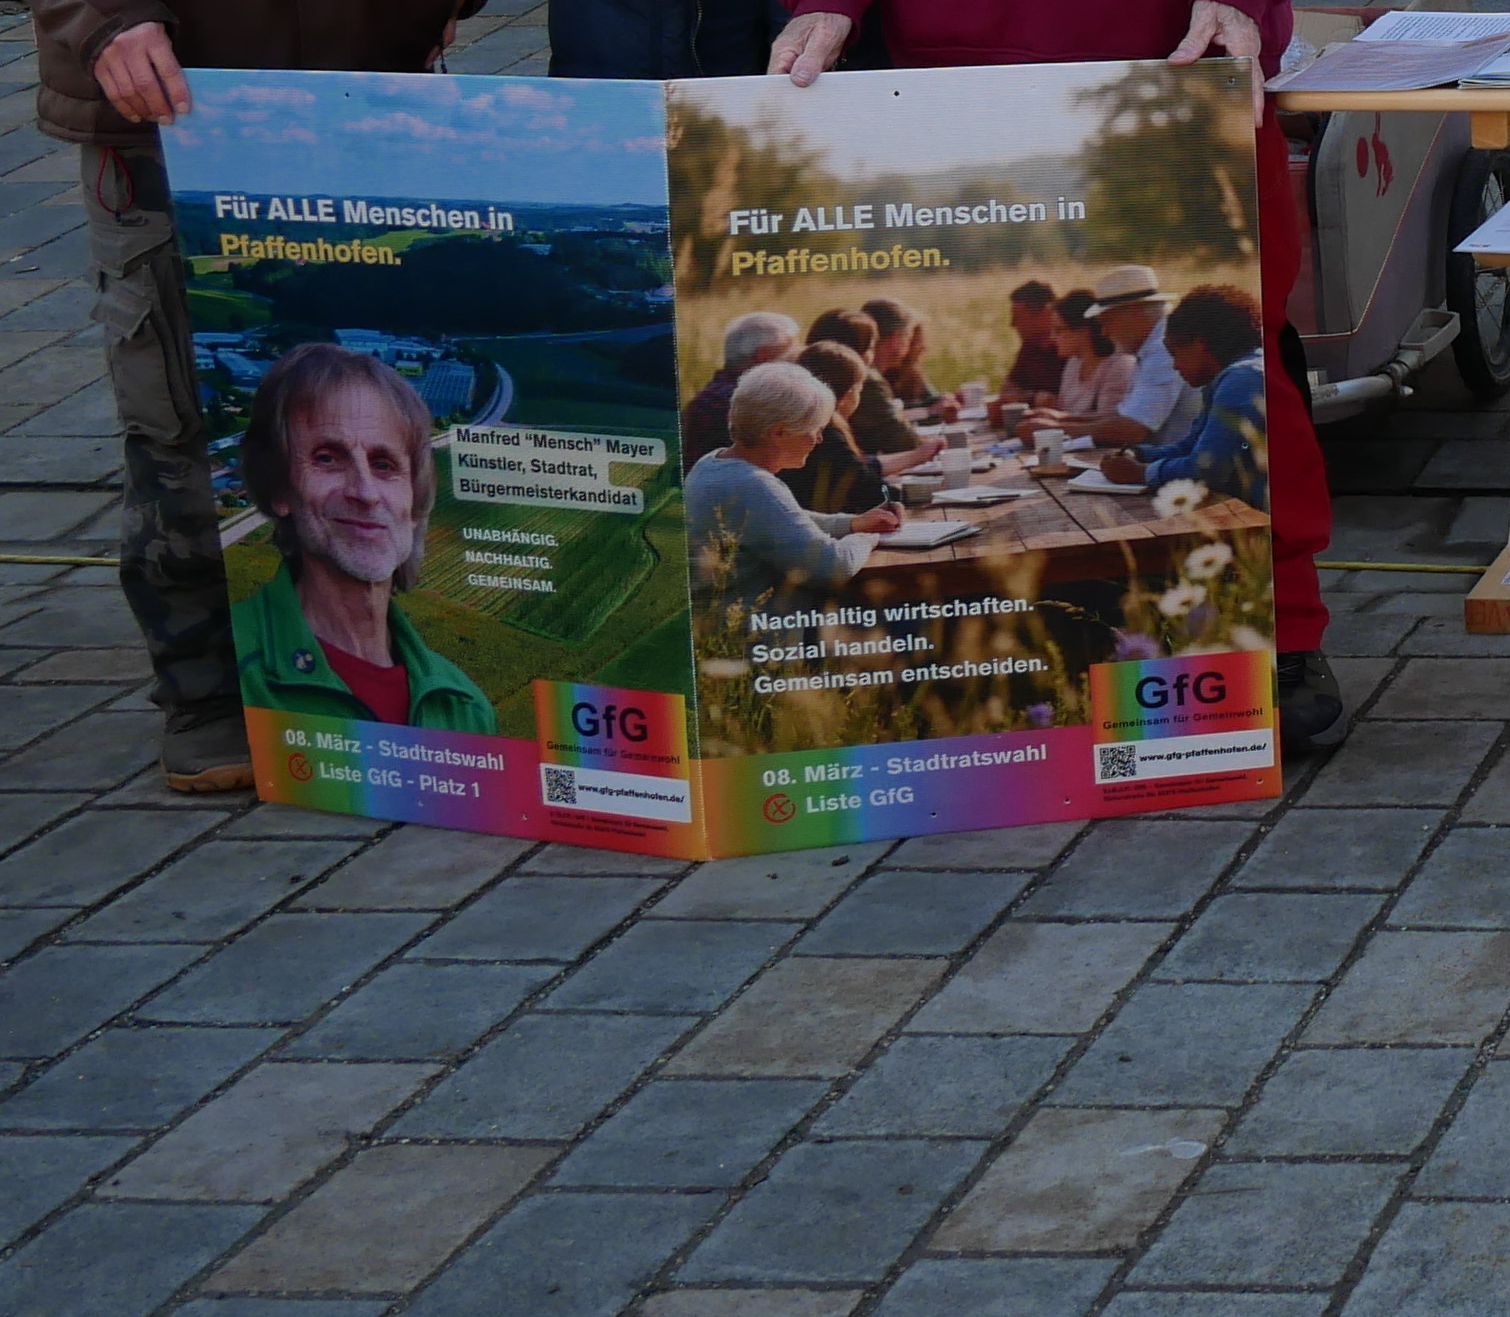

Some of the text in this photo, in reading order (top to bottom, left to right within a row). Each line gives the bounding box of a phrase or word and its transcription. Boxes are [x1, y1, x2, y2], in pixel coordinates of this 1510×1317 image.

[214, 194, 514, 231] Für ALLE Menschen in
[728, 196, 1086, 235] Für ALLE Menschen in
[220, 233, 402, 266] Pfaffenhofen.
[731, 243, 951, 276] Pfaffenhofen.
[456, 428, 521, 447] Manfred
[606, 439, 655, 459] Mayer
[458, 453, 598, 480] Künstler, Stadtrat,
[459, 478, 638, 507] Bürgermeisterkandidat
[461, 526, 559, 548] UNABHÄNGIG.
[464, 550, 554, 571] NACHHALTIG.
[467, 573, 558, 593] GEMEINSAM.
[751, 597, 1035, 632] Nachhaltig wirtschaften.
[752, 633, 935, 663] Sozial handeln.
[754, 656, 1049, 695] Gemeinsam entscheiden.
[1134, 671, 1227, 709] GfG
[571, 701, 649, 743] GfG
[1102, 707, 1264, 731] Gemeinsam für Gemeinwohl
[285, 728, 505, 772] 08. März Stadtratswahl
[546, 740, 602, 757] Gemeinsam
[603, 747, 618, 758] für
[761, 743, 1048, 788] 08. März Stadtratswahl
[319, 761, 481, 798] Liste GfG Platz 1
[806, 786, 915, 814] Liste GfG
